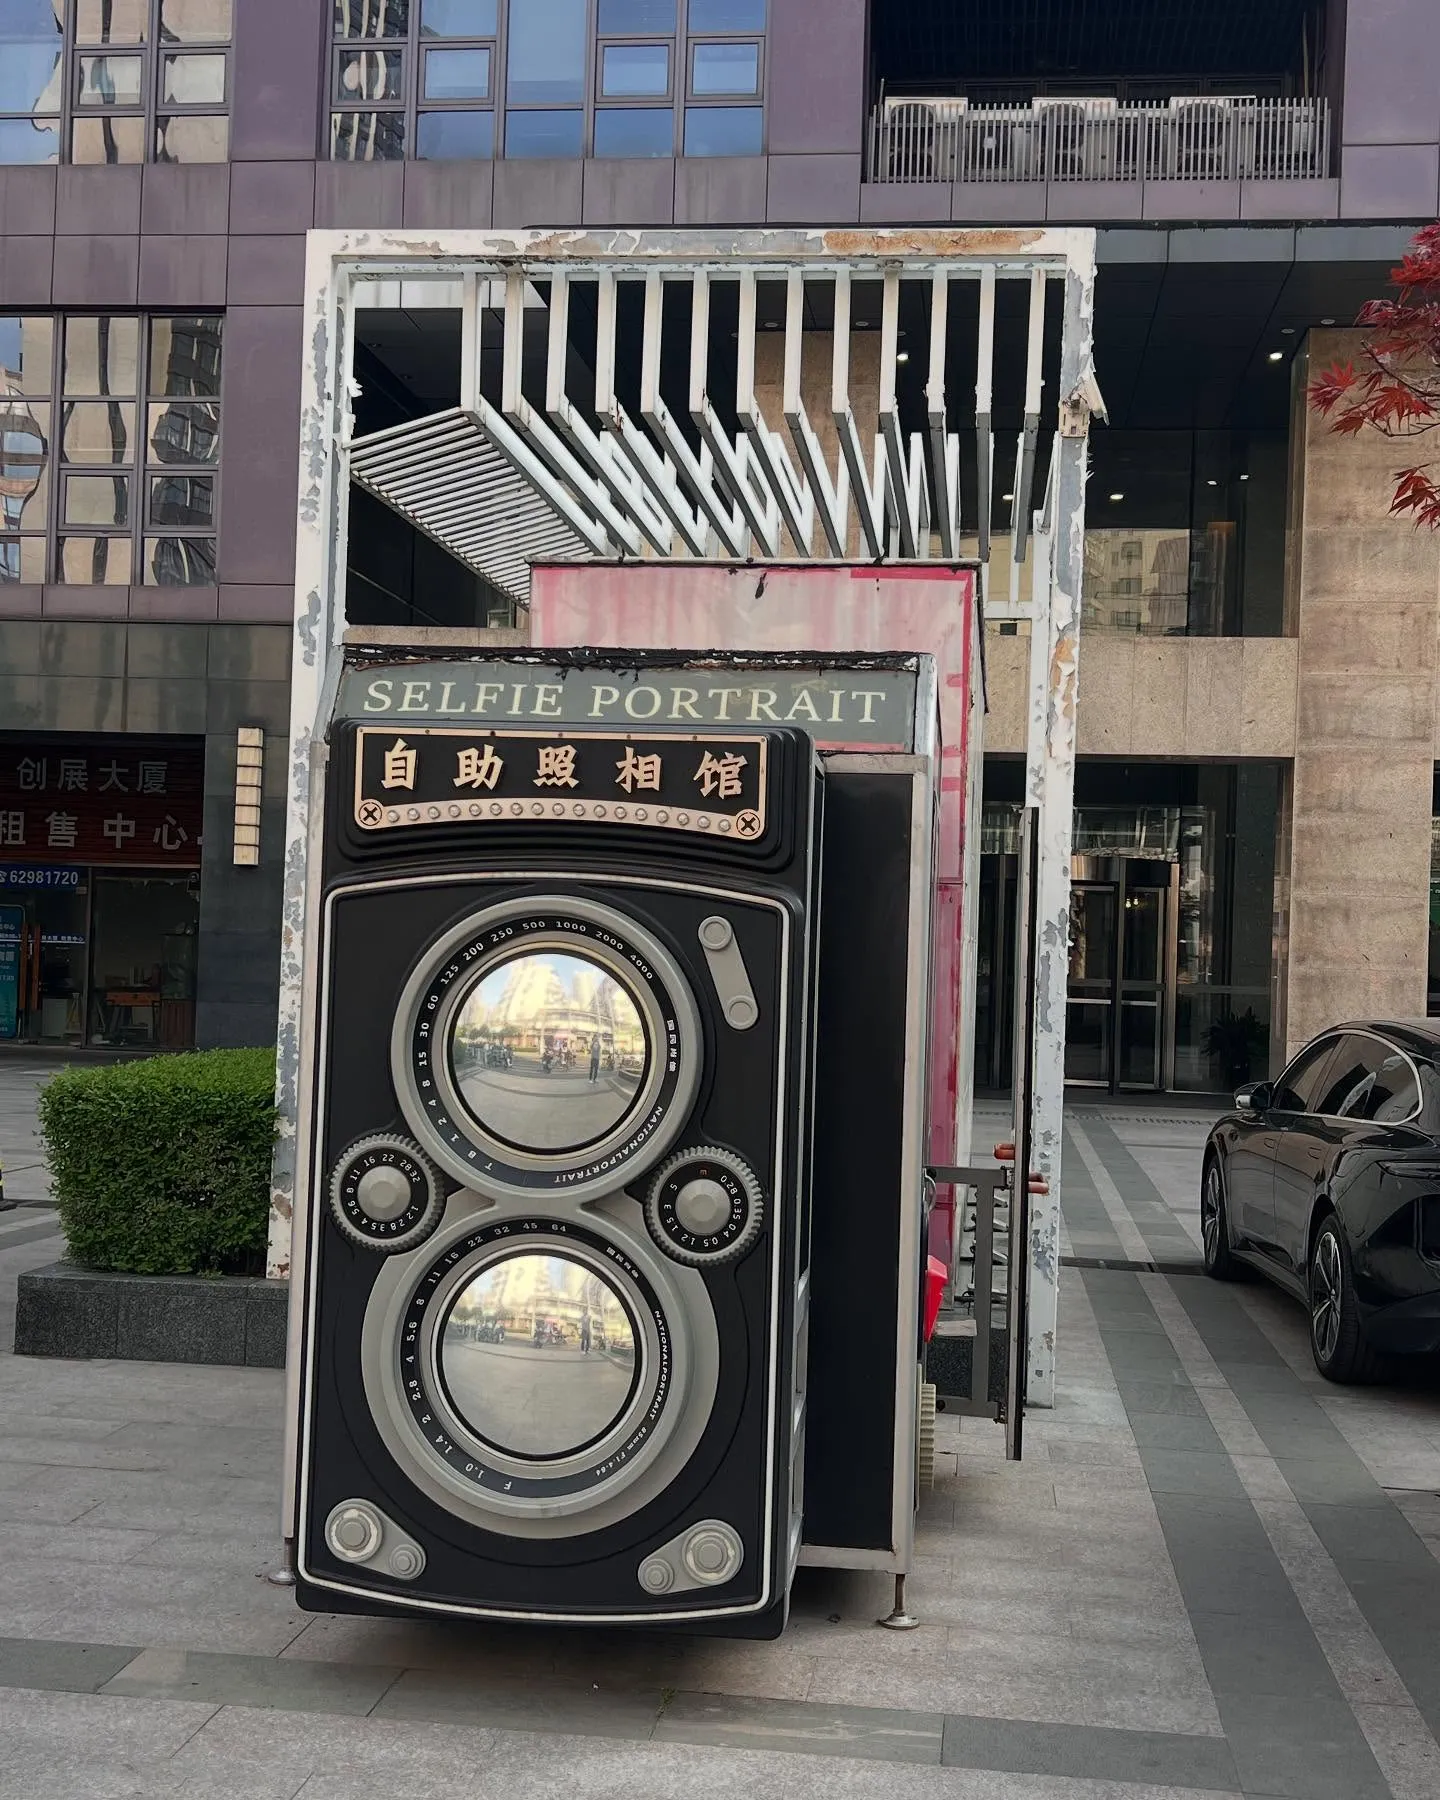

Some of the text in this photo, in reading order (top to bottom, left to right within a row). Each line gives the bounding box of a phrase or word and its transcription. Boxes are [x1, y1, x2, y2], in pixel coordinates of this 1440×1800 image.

[363, 678, 887, 723] SELFIE PORTRAIT
[16, 757, 168, 794] 创展大厦
[381, 738, 747, 799] 自助照相馆
[10, 870, 78, 884] 62981720
[522, 921, 545, 930] 500
[555, 921, 586, 932] 1000
[491, 927, 513, 943] 250
[596, 930, 623, 949] 2000
[463, 942, 484, 961] 200
[441, 964, 459, 984] 125
[630, 954, 653, 979] 4000
[428, 994, 438, 1010] 60
[420, 1022, 429, 1038] 30
[419, 1052, 427, 1067] 15
[428, 1099, 437, 1107] 4
[438, 1118, 447, 1126] 2
[451, 1133, 460, 1142] 1
[554, 1106, 663, 1182] NATIONALPORTRAIT
[468, 1150, 476, 1159] B
[350, 1169, 360, 1181] 11
[363, 1156, 375, 1166] 16
[382, 1154, 394, 1162] 22
[400, 1160, 412, 1171] 28
[410, 1170, 420, 1182] 32
[485, 1162, 494, 1171] T
[495, 1225, 510, 1235] 32
[523, 1222, 538, 1230] 45
[552, 1224, 566, 1232] 64
[468, 1236, 484, 1248] 22
[445, 1251, 459, 1265] 16
[428, 1271, 441, 1284] 11
[407, 1321, 417, 1342] 5.6
[649, 1310, 669, 1421] NATIONALPORTRAIT
[409, 1379, 421, 1401] 2.8
[435, 1434, 452, 1454] 1.4
[465, 1463, 484, 1478] 1.0
